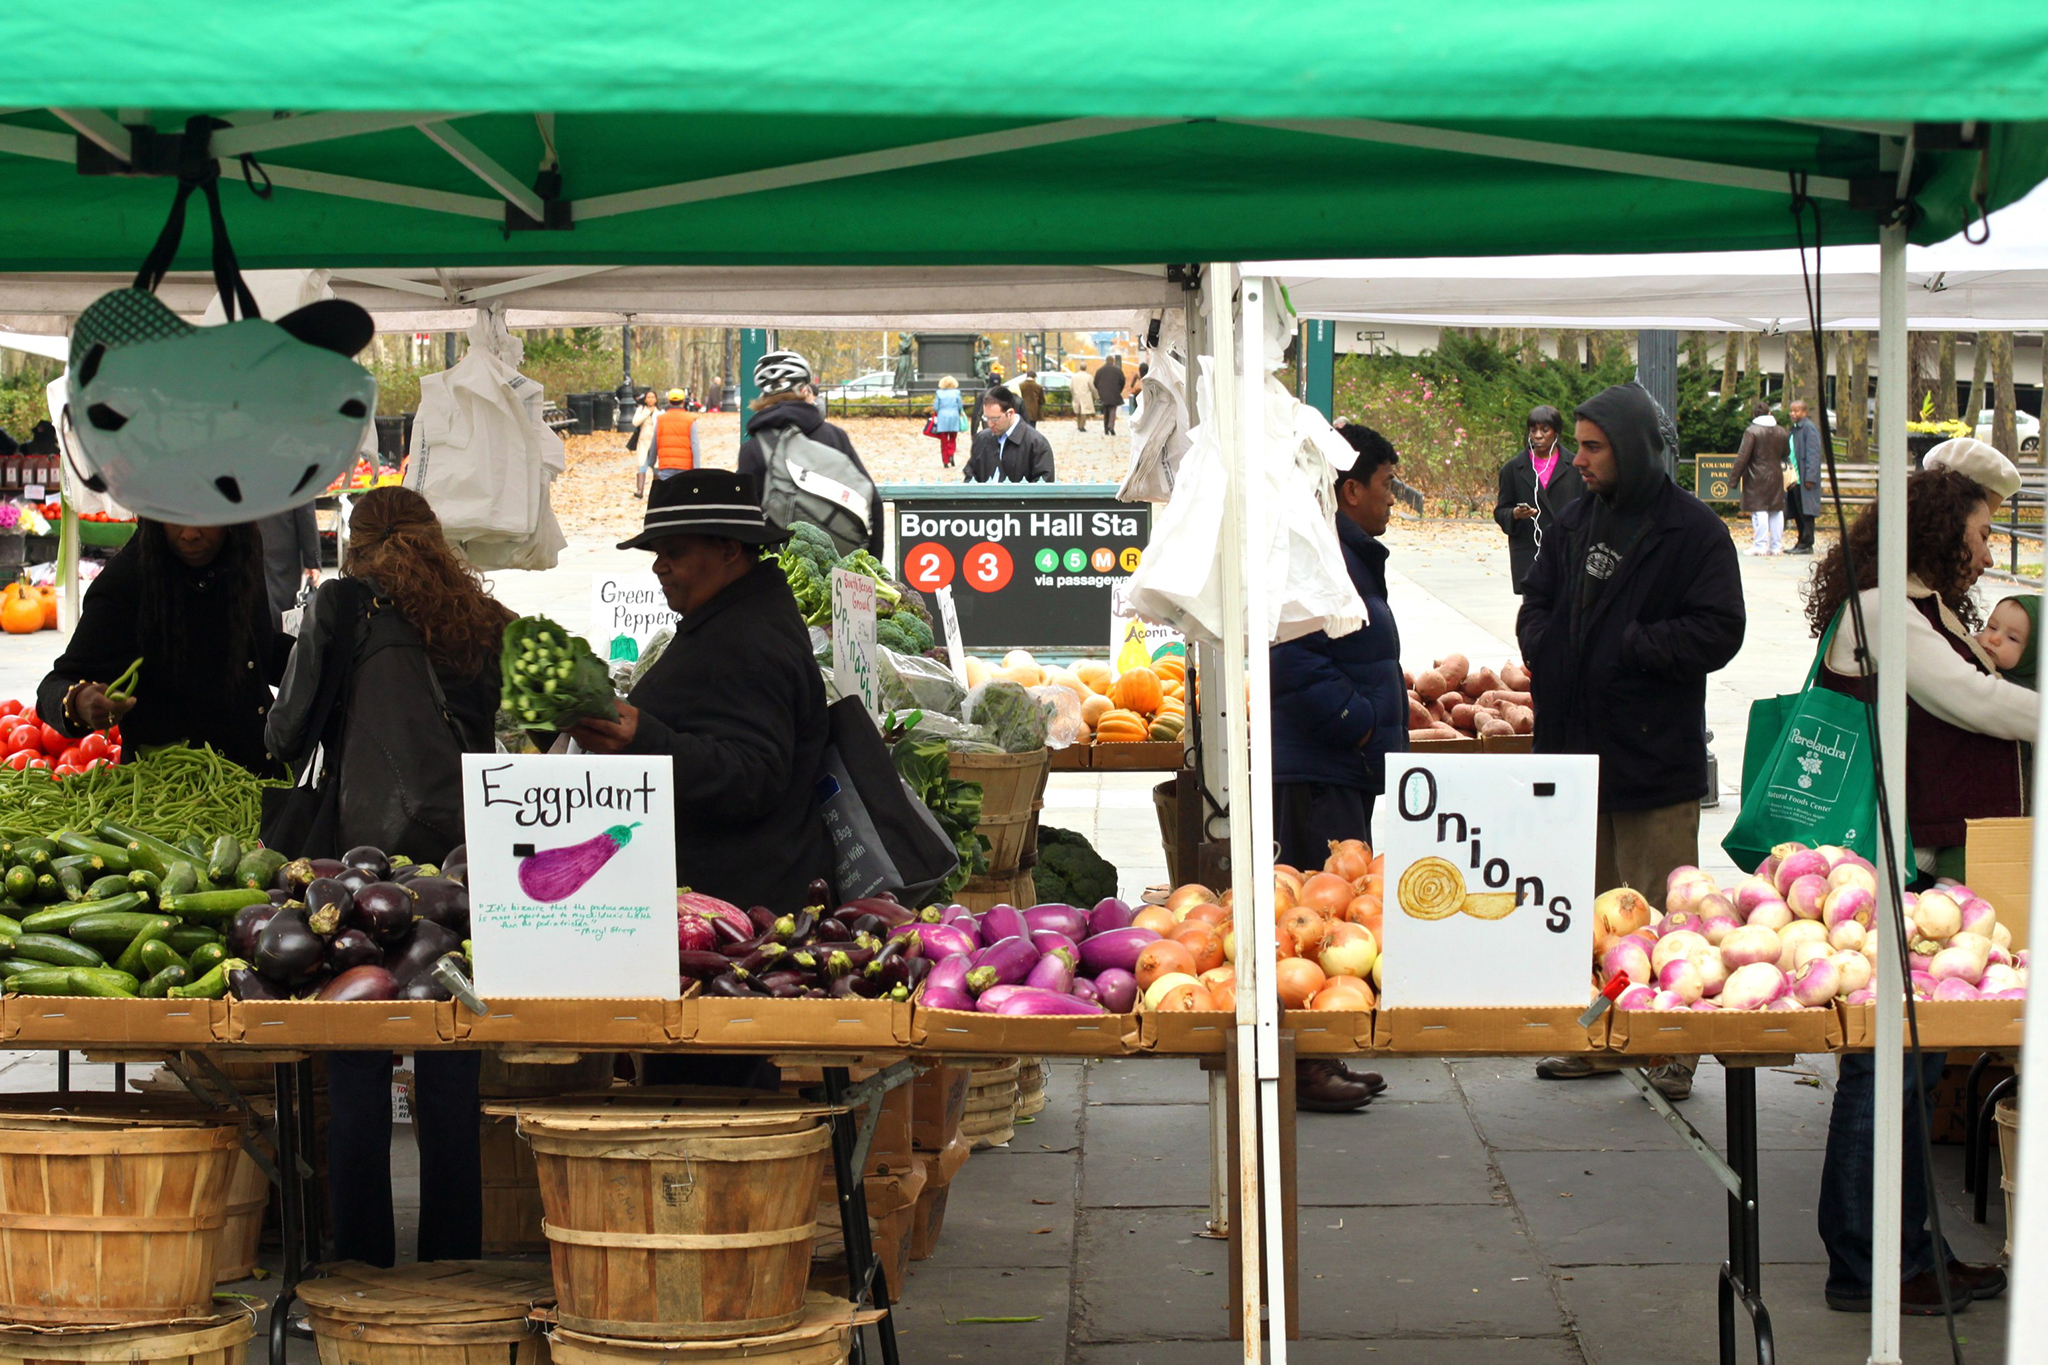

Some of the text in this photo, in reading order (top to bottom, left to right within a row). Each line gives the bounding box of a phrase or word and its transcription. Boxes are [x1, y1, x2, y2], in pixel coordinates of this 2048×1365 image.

[901, 512, 1137, 542] Borough Hall Sta
[919, 552, 999, 582] 2 3
[1041, 553, 1138, 567] 4 5 M R
[601, 580, 654, 604] Green
[1034, 574, 1131, 588] via passagewa
[834, 577, 872, 709] Spinach
[1124, 626, 1168, 644] Acorn
[1788, 727, 1847, 760] Perelandra
[482, 763, 656, 827] Eggplant
[1789, 795, 1808, 806] Foods
[1810, 801, 1832, 812] Center
[847, 843, 866, 861] With
[1398, 767, 1572, 933] Onions
[478, 914, 486, 922] is
